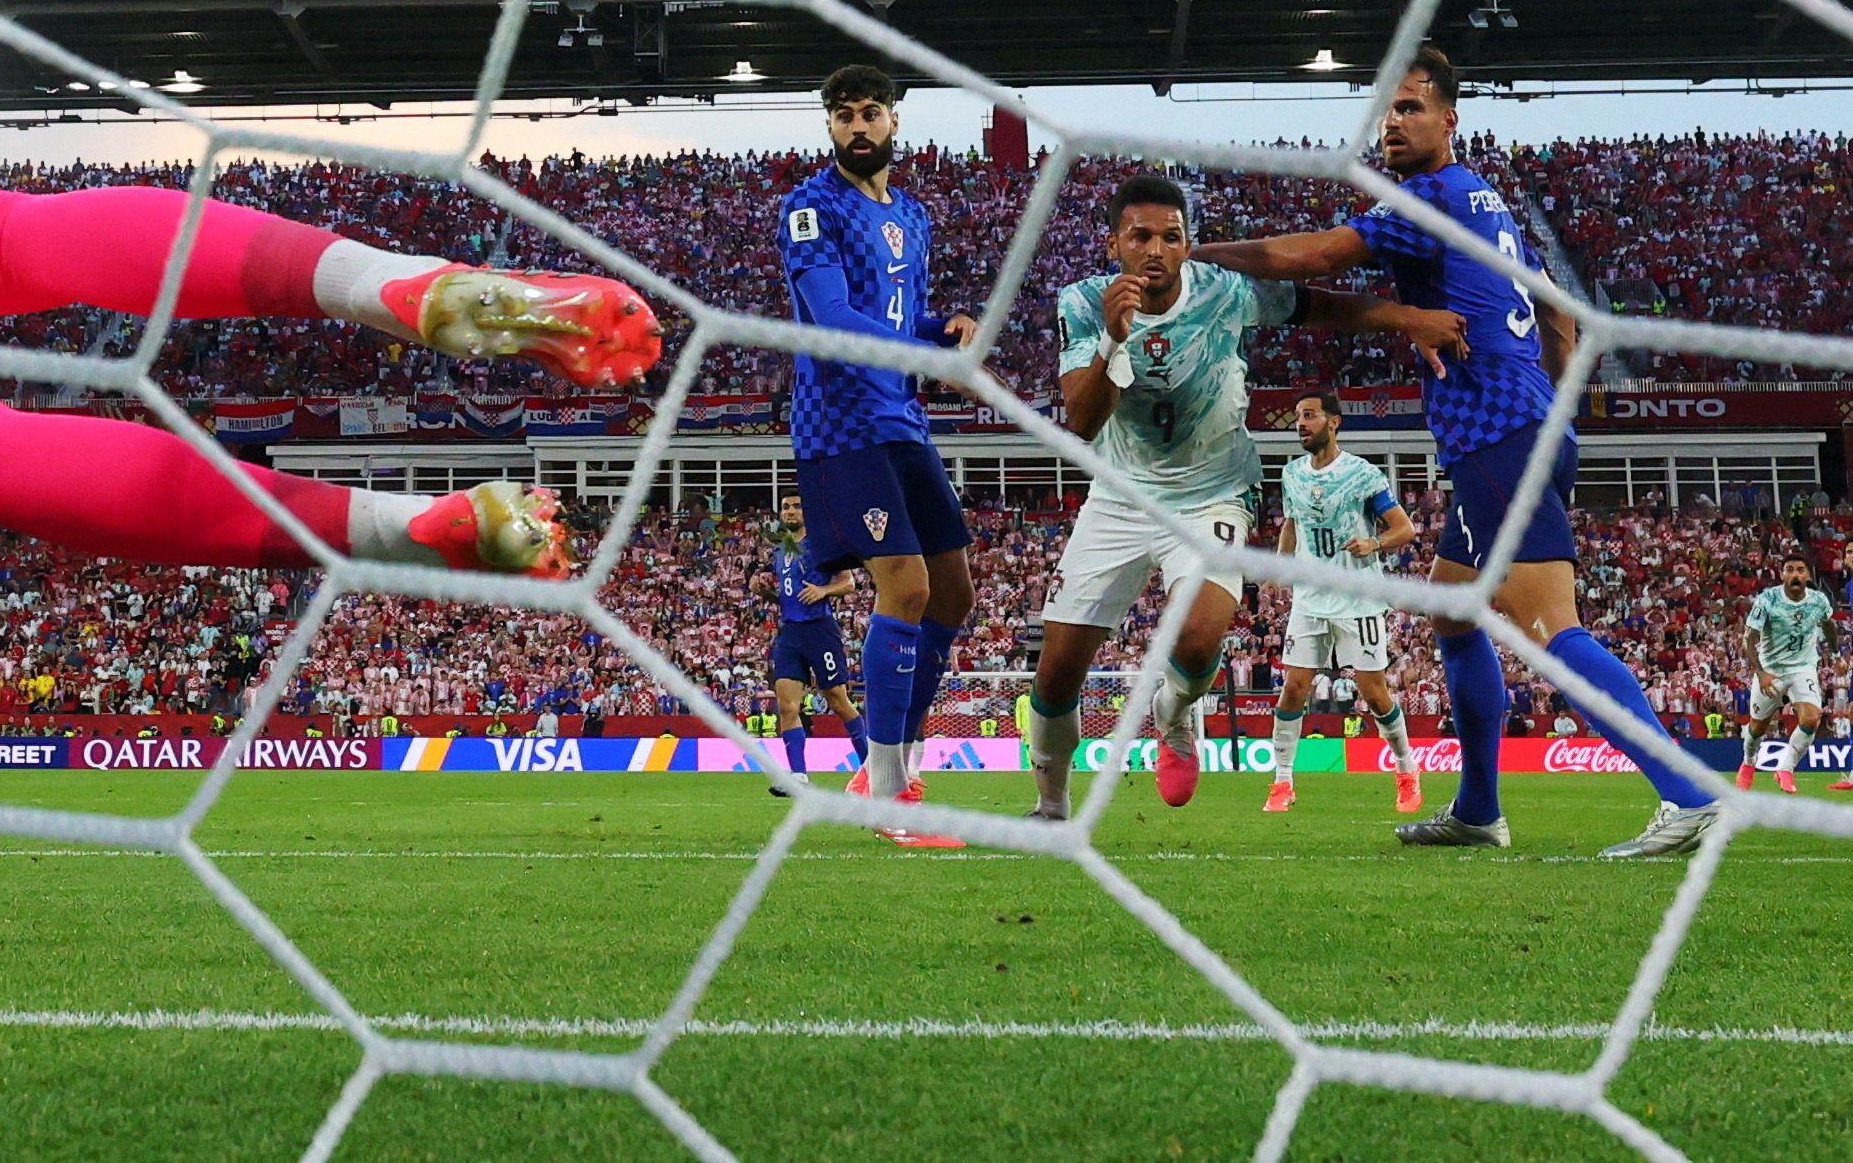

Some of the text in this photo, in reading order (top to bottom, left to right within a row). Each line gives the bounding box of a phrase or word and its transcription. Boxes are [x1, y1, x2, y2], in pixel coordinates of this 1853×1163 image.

[1498, 230, 1536, 338] 3
[887, 287, 904, 331] 4
[1153, 401, 1175, 444] 9
[1311, 527, 1336, 558] 10
[784, 577, 793, 597] 8
[1354, 616, 1379, 646] 10
[1788, 635, 1805, 652] 21
[823, 651, 836, 672] 8
[83, 739, 203, 770] QATAR
[485, 738, 584, 771] VISA
